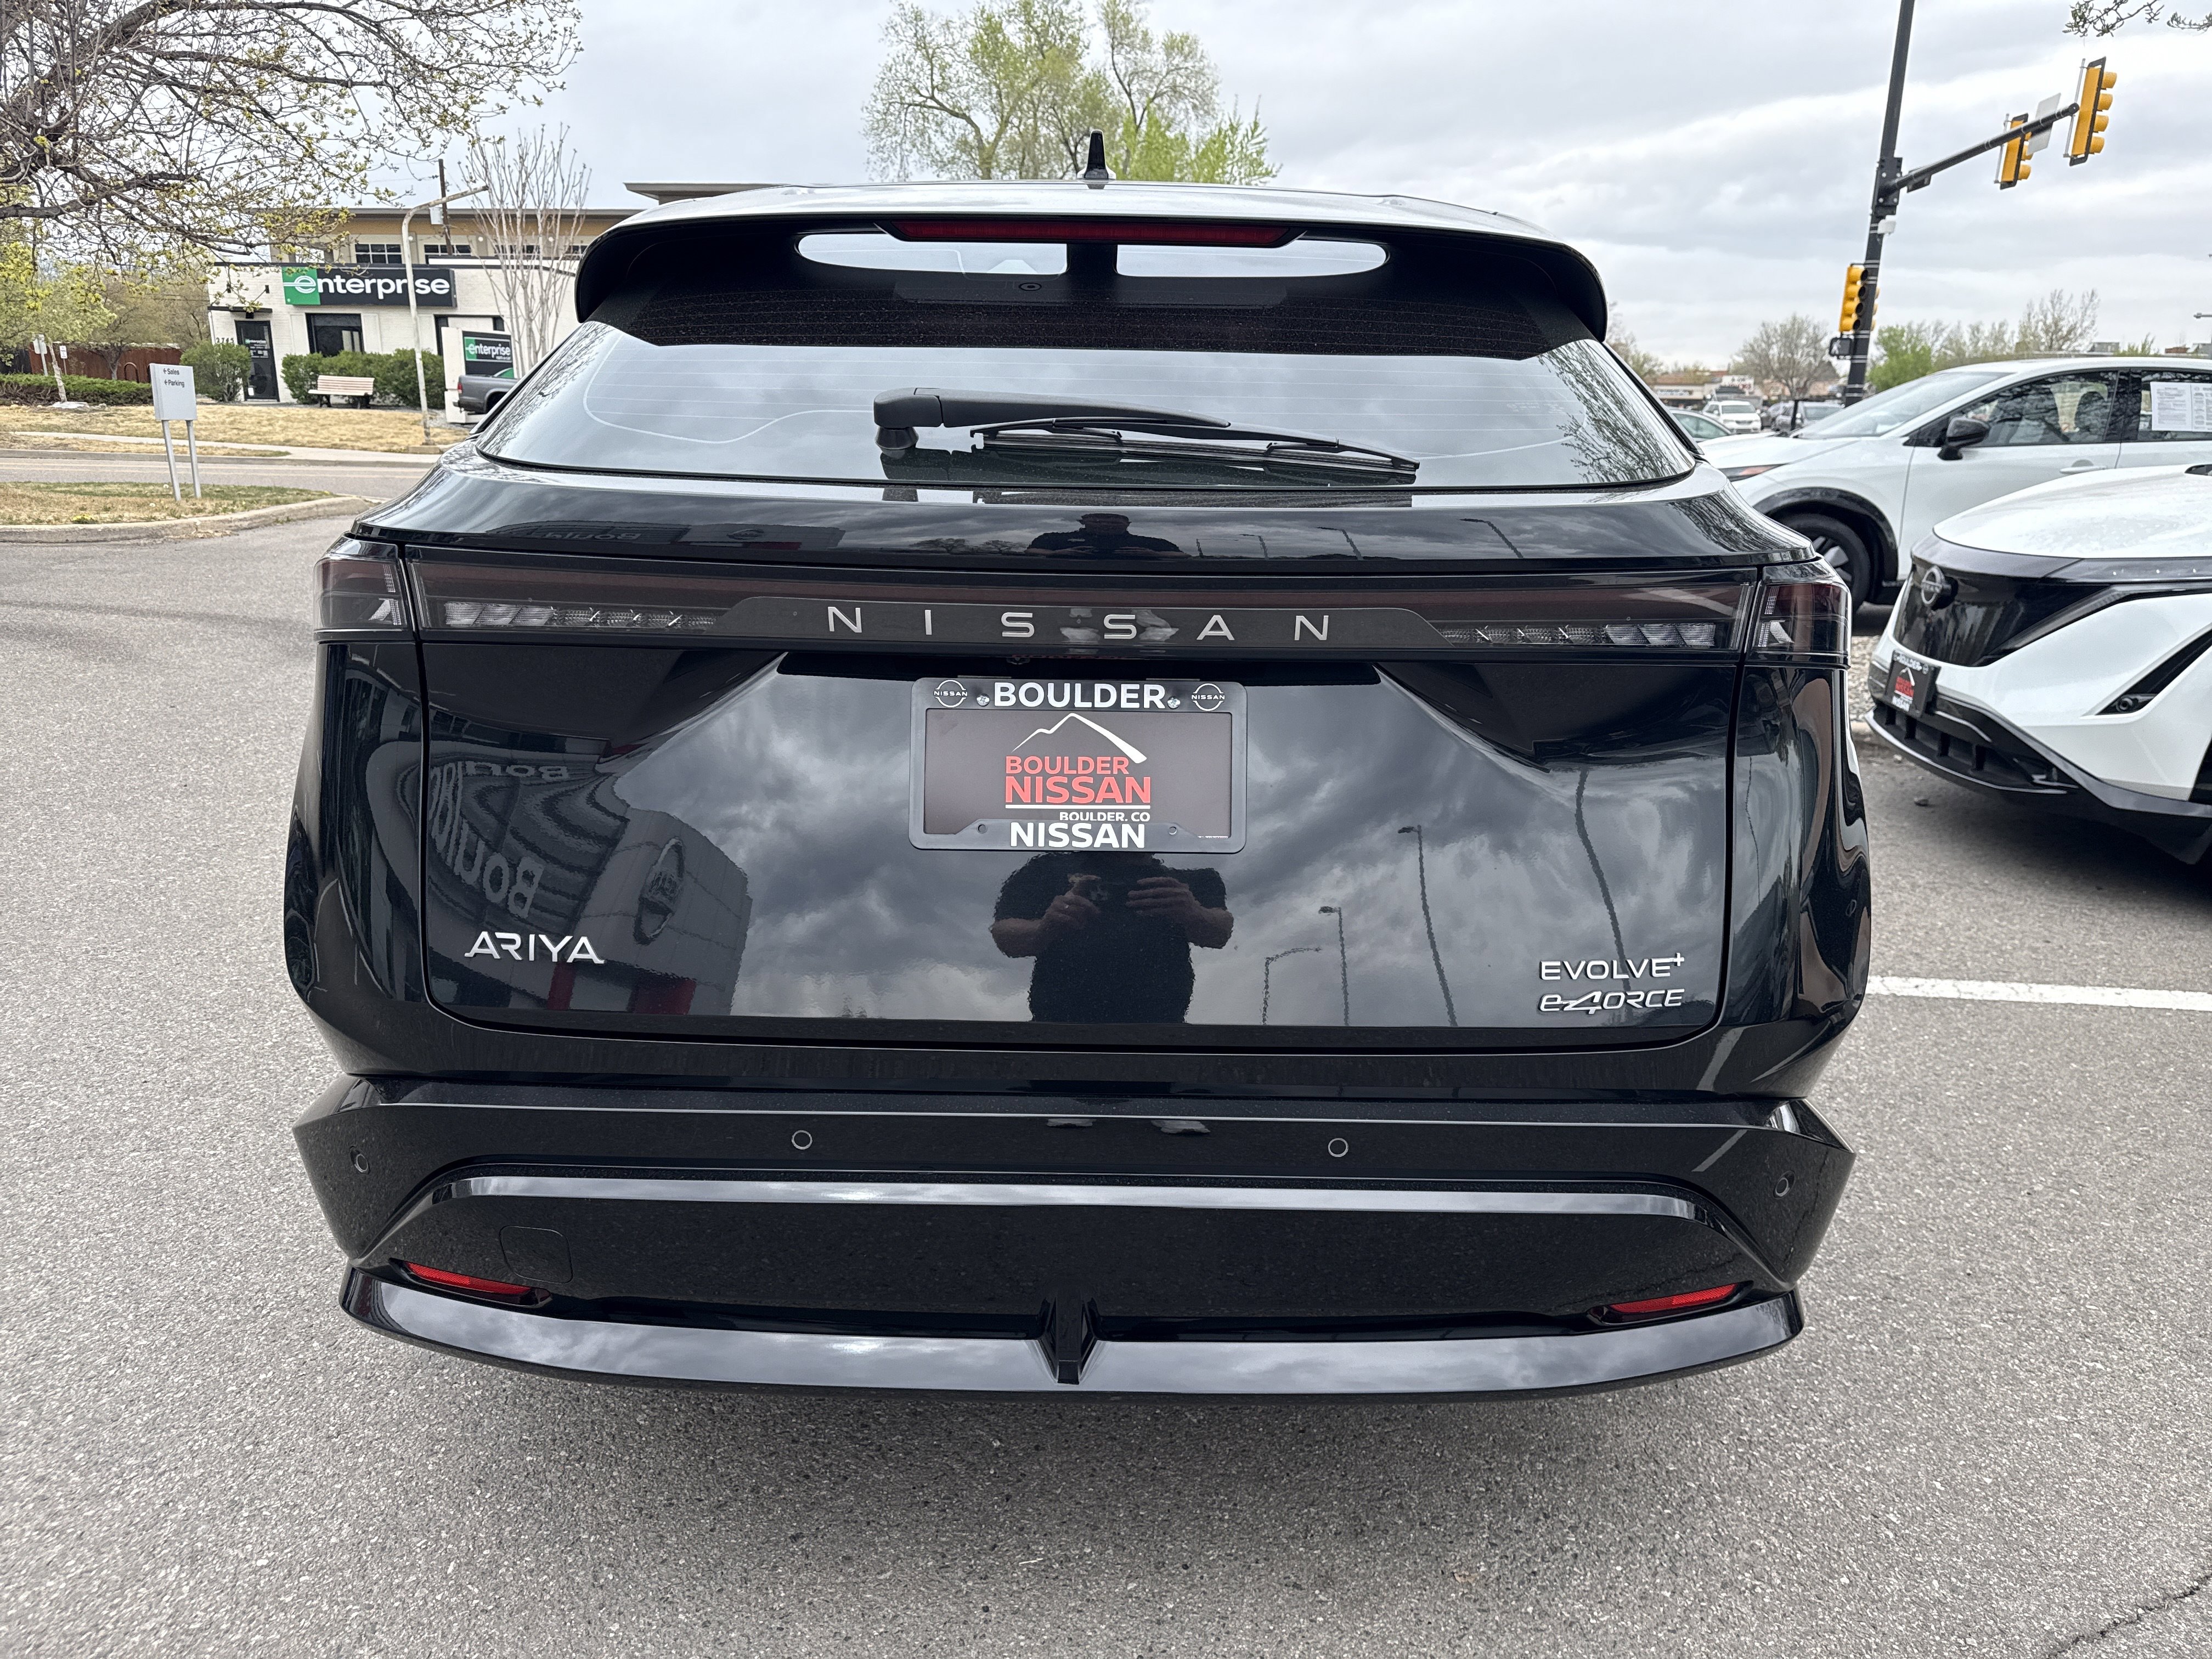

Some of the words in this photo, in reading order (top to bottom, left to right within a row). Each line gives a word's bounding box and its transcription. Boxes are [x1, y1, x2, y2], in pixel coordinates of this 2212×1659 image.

[284, 275, 450, 300] enterprse
[466, 343, 511, 358] enterprise
[168, 380, 185, 388] Parking
[827, 606, 1329, 641] NISSAN
[994, 682, 1165, 709] BOULDER
[1006, 755, 1130, 775] BOULDER
[1005, 776, 1151, 804] NISSAN
[1131, 811, 1150, 822] CO
[1009, 822, 1145, 848] NISSAN
[464, 931, 605, 964] ARIYA
